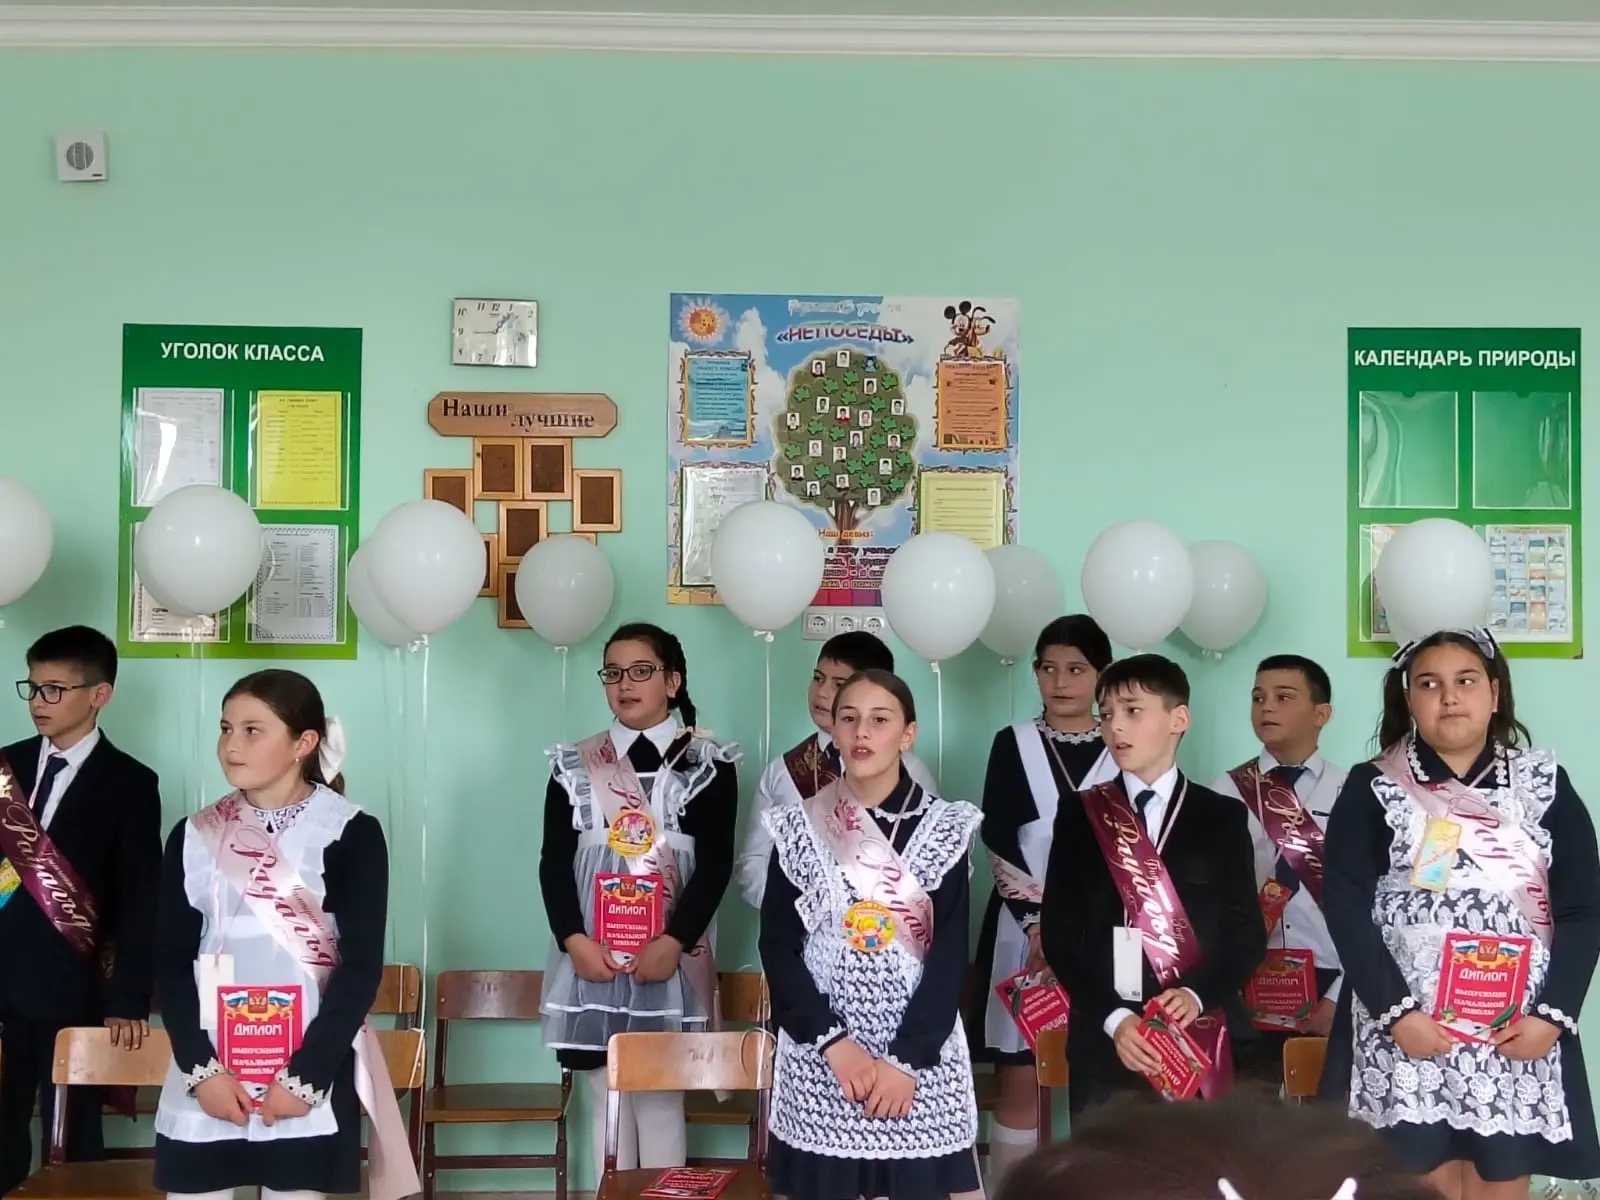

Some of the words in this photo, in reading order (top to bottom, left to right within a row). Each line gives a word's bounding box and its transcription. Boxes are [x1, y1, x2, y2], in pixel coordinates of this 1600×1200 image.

[477, 302, 485, 311] 11
[492, 303, 500, 311] 12
[161, 342, 239, 360] УГОЛОК
[245, 344, 325, 362] КЛАССА
[1354, 350, 1472, 369] КАЛЕНДАРЬ
[1478, 350, 1576, 369] ПРИРОДЫ
[443, 398, 507, 417] Наши
[511, 413, 595, 432] лучшие
